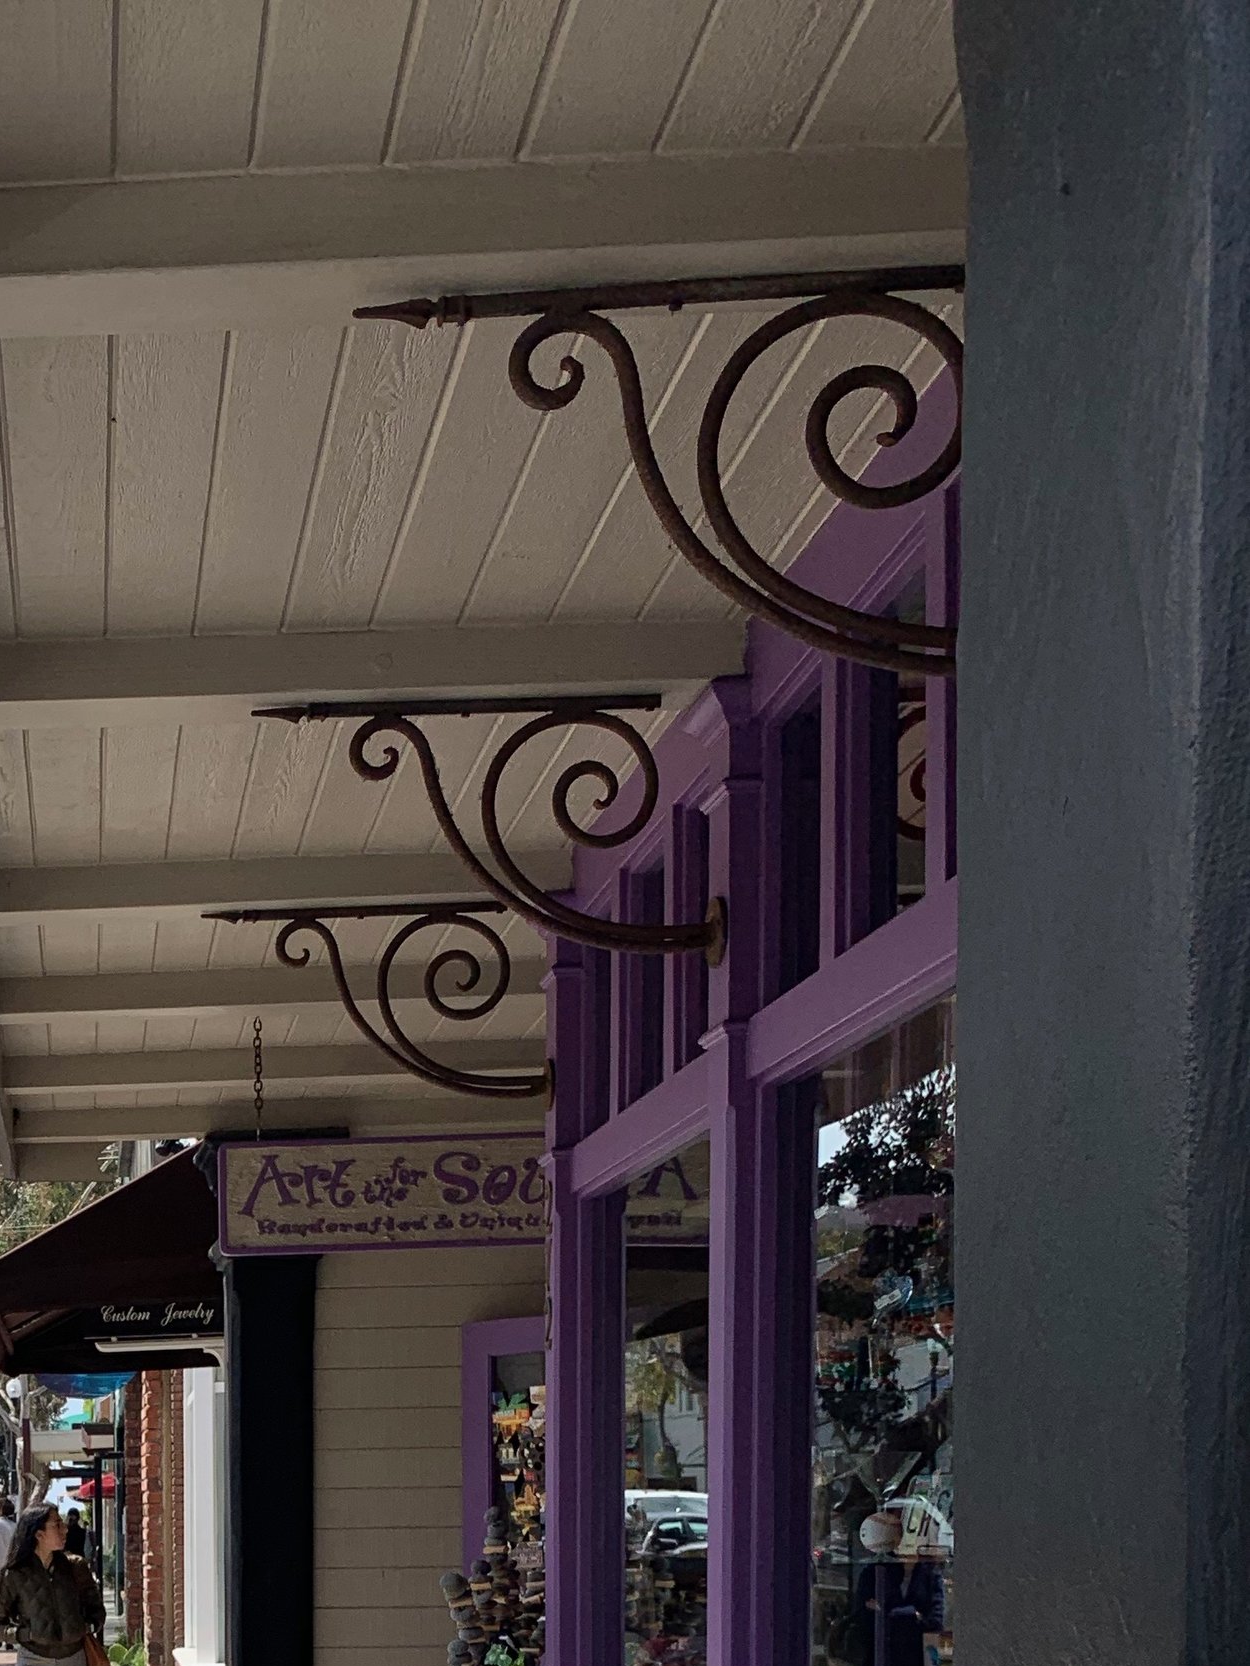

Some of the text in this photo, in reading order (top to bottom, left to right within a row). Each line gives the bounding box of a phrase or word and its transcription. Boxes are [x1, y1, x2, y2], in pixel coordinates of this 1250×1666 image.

[238, 1150, 547, 1216] Art for the Sou
[257, 1215, 428, 1238] Handcrafted
[433, 1215, 454, 1230] &
[100, 1302, 215, 1327] Custom Jewelry
